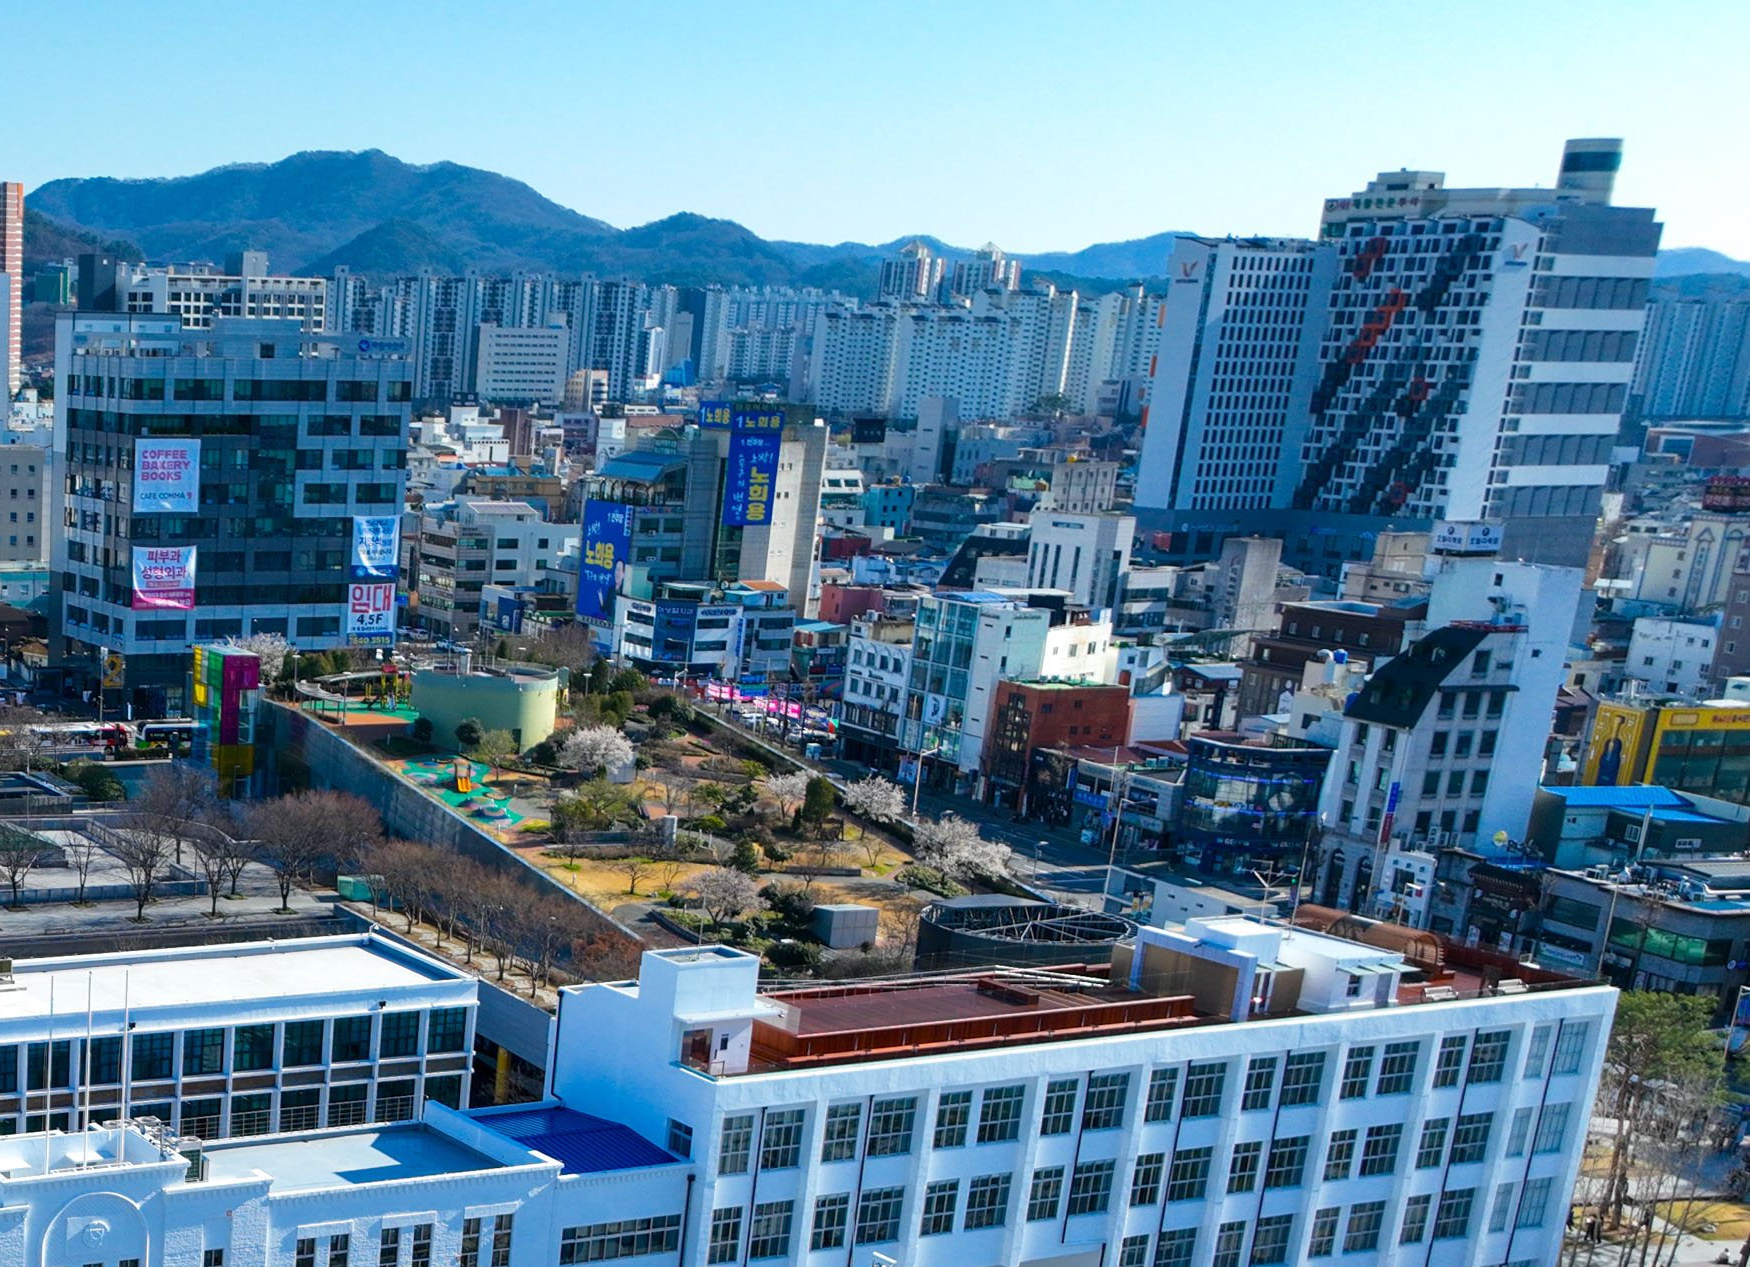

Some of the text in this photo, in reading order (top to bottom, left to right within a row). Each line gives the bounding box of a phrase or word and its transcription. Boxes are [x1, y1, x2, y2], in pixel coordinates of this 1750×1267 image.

[736, 416, 743, 428] 1
[142, 450, 187, 459] COFFEE
[142, 461, 190, 470] BAKERY
[141, 472, 182, 480] BOOKS
[147, 549, 181, 563] 피부과
[585, 540, 614, 570] 노희용
[142, 565, 186, 579] 성형외과
[351, 584, 392, 613] 임대
